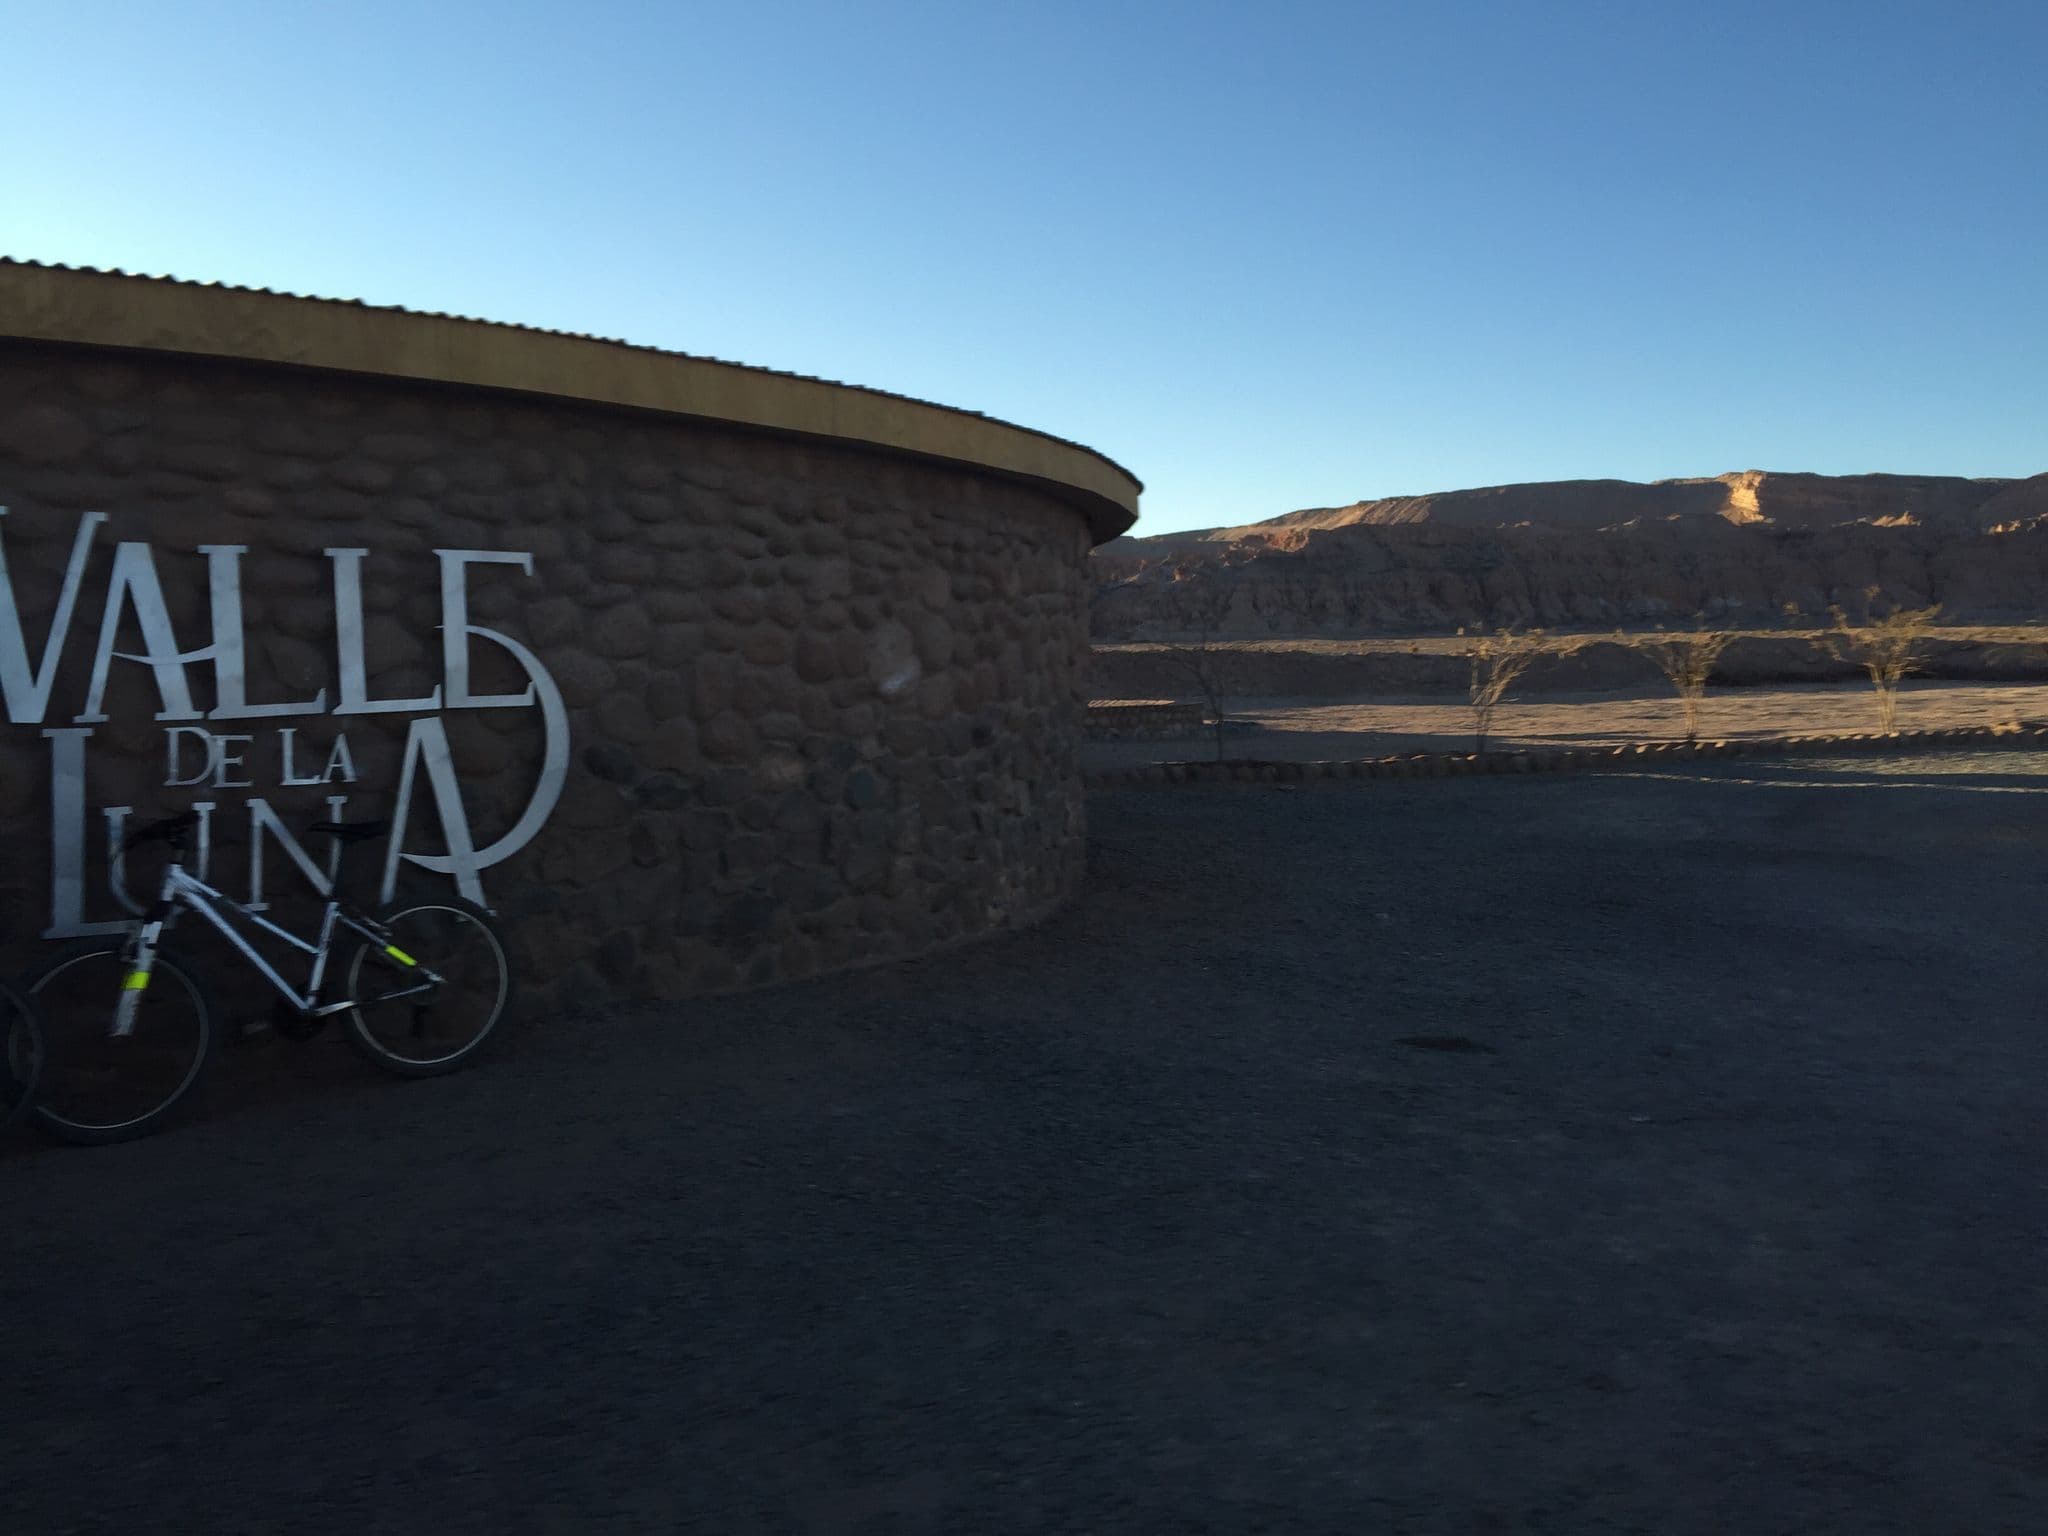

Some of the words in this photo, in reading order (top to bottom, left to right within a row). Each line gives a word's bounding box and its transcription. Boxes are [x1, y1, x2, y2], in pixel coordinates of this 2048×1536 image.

[0, 506, 538, 725] VALLE
[40, 716, 502, 940] LUNA
[162, 726, 254, 788] DE
[277, 728, 358, 786] LA
